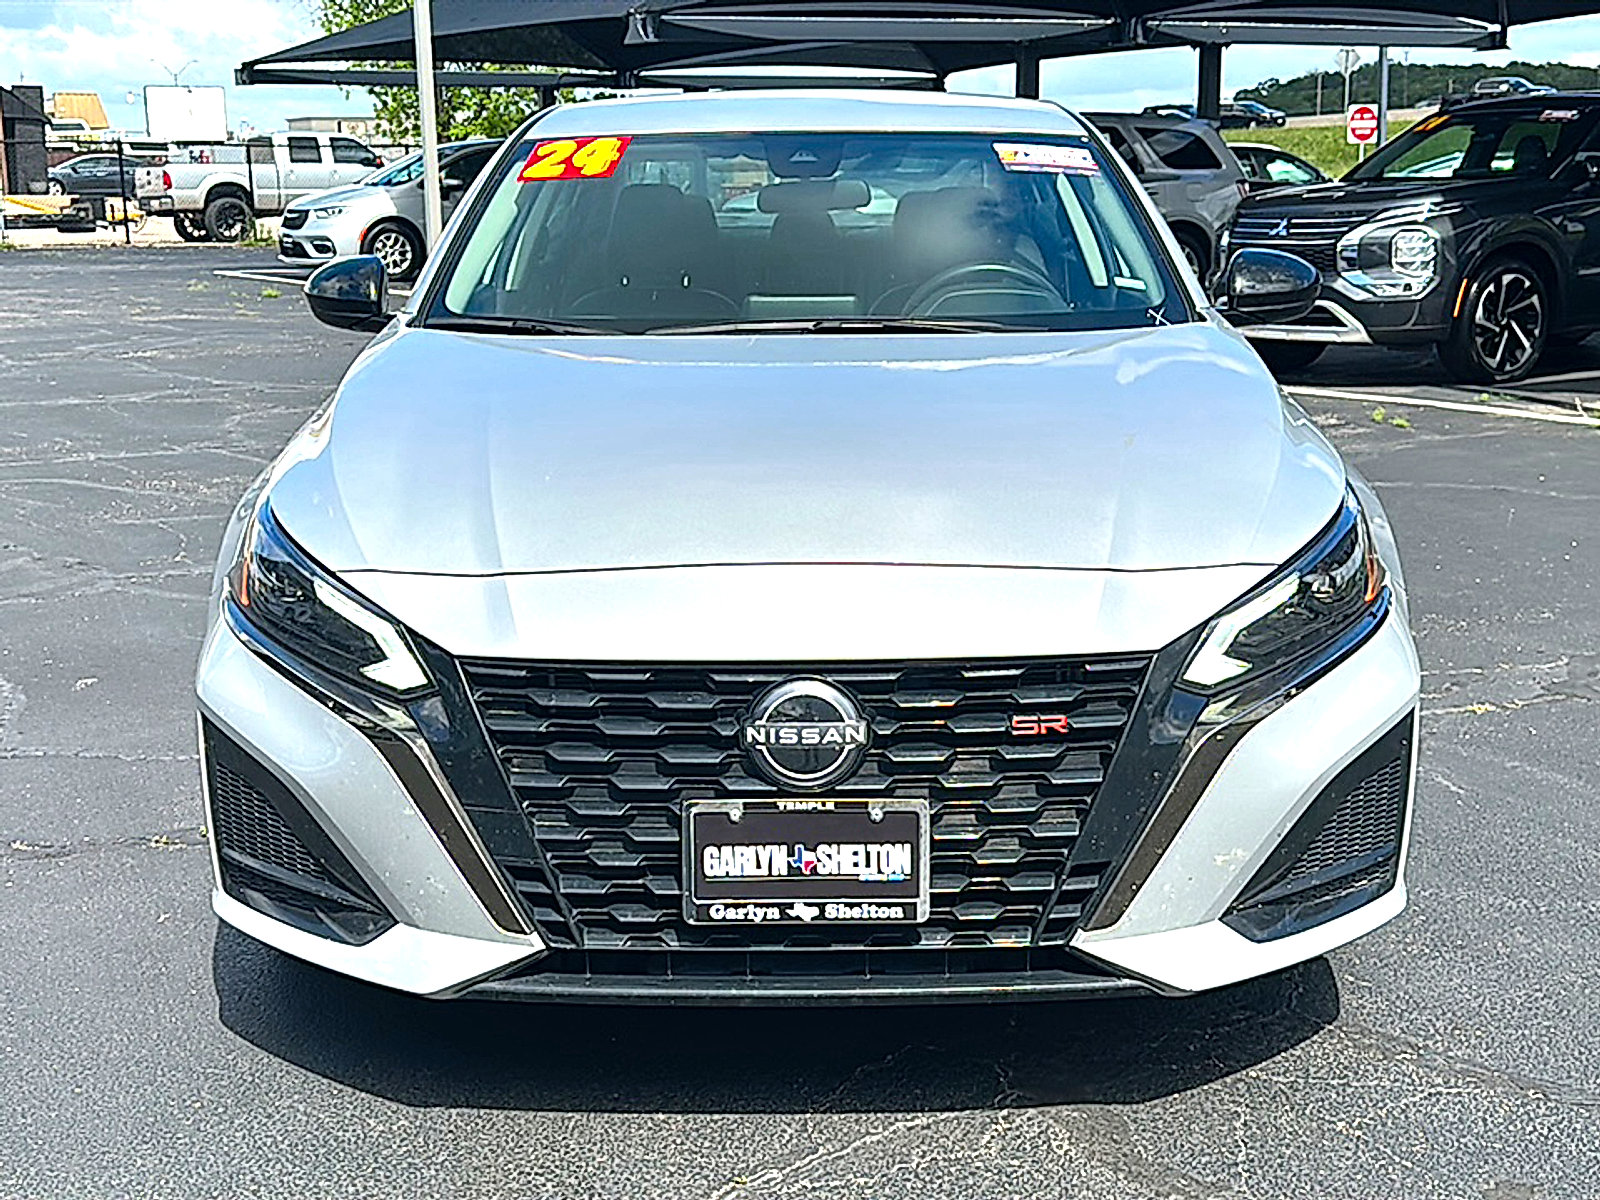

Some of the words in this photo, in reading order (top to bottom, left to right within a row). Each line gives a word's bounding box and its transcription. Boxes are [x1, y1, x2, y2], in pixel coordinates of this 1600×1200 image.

[523, 138, 621, 178] 24
[1011, 714, 1068, 735] SR
[746, 725, 866, 745] NISSAN
[777, 801, 835, 811] TEMPLE
[703, 844, 788, 877] GARLYN
[815, 843, 912, 876] SHELTON
[709, 904, 781, 923] Garlyn
[824, 903, 904, 920] Shelton
